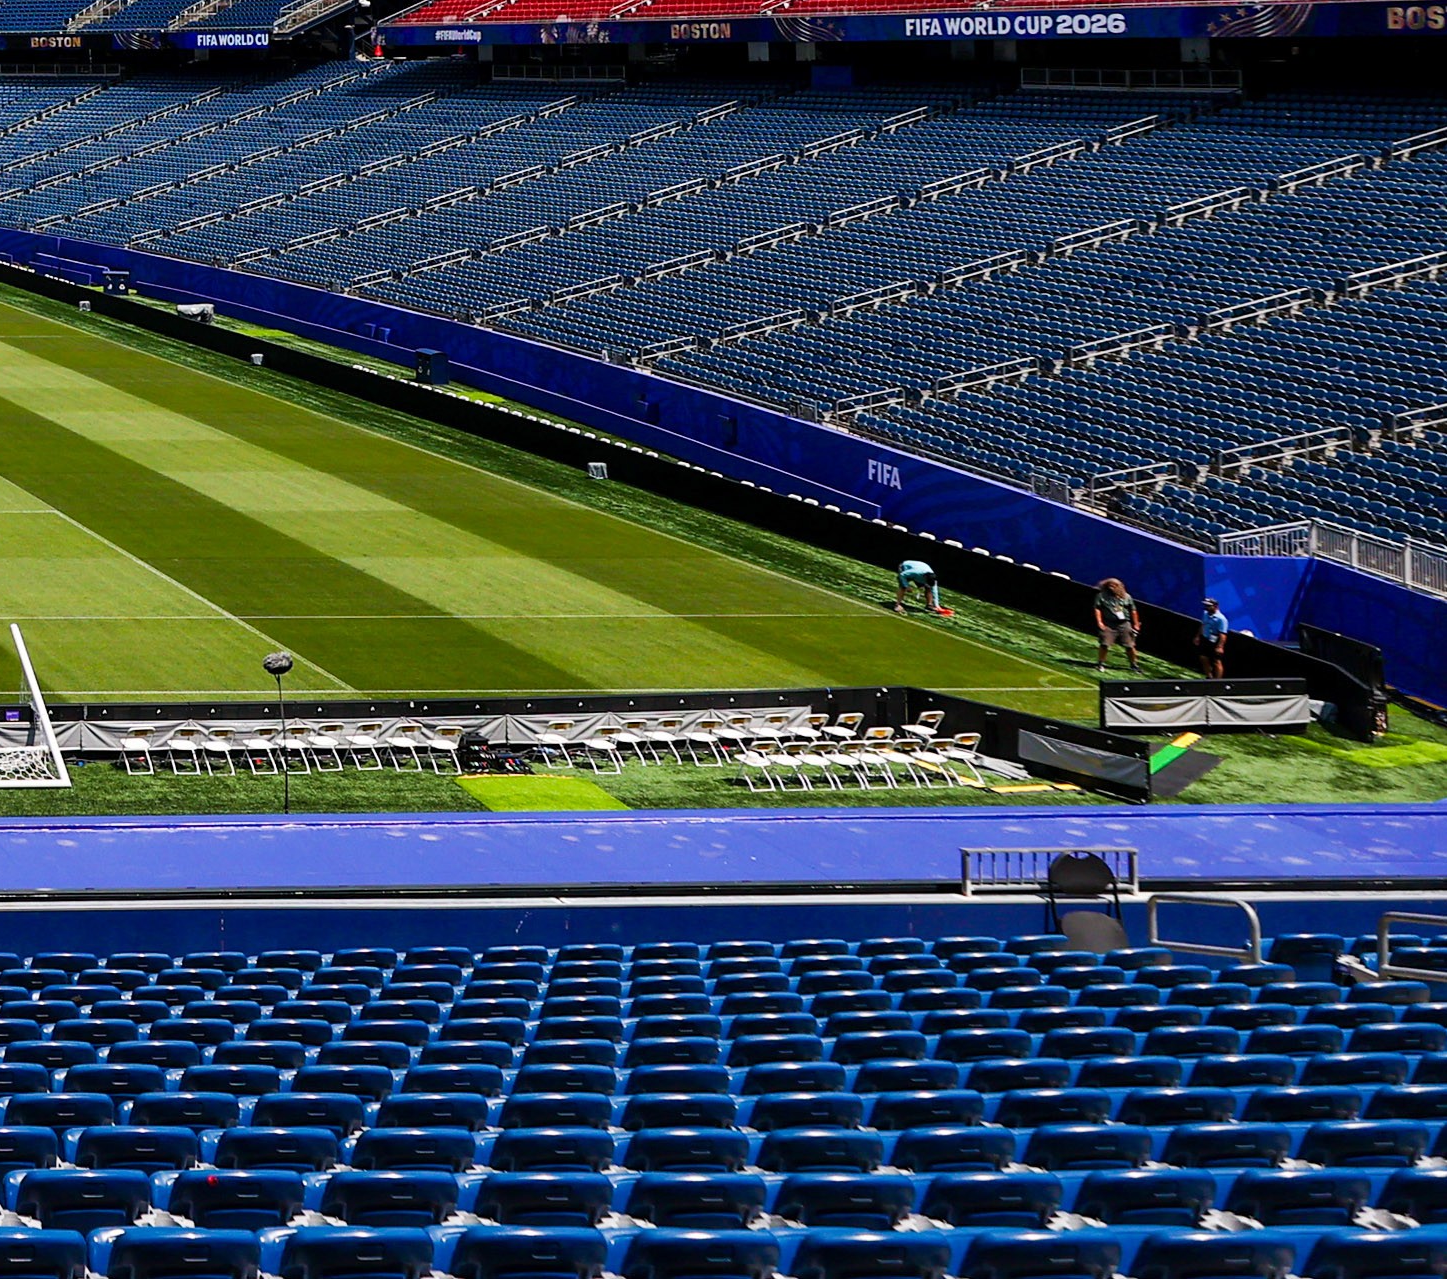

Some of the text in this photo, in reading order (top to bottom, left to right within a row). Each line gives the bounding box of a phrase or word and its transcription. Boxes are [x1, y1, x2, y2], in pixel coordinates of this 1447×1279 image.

[905, 13, 1126, 36] FIFA WORLD CUP 2026
[1386, 6, 1447, 30] BOS
[435, 29, 482, 42] #FIFAWorldCup
[670, 23, 731, 39] BOSTON
[30, 37, 81, 48] BOSTON
[197, 34, 218, 47] FIFA
[219, 34, 254, 46] WORLD
[868, 458, 902, 490] FIFA
